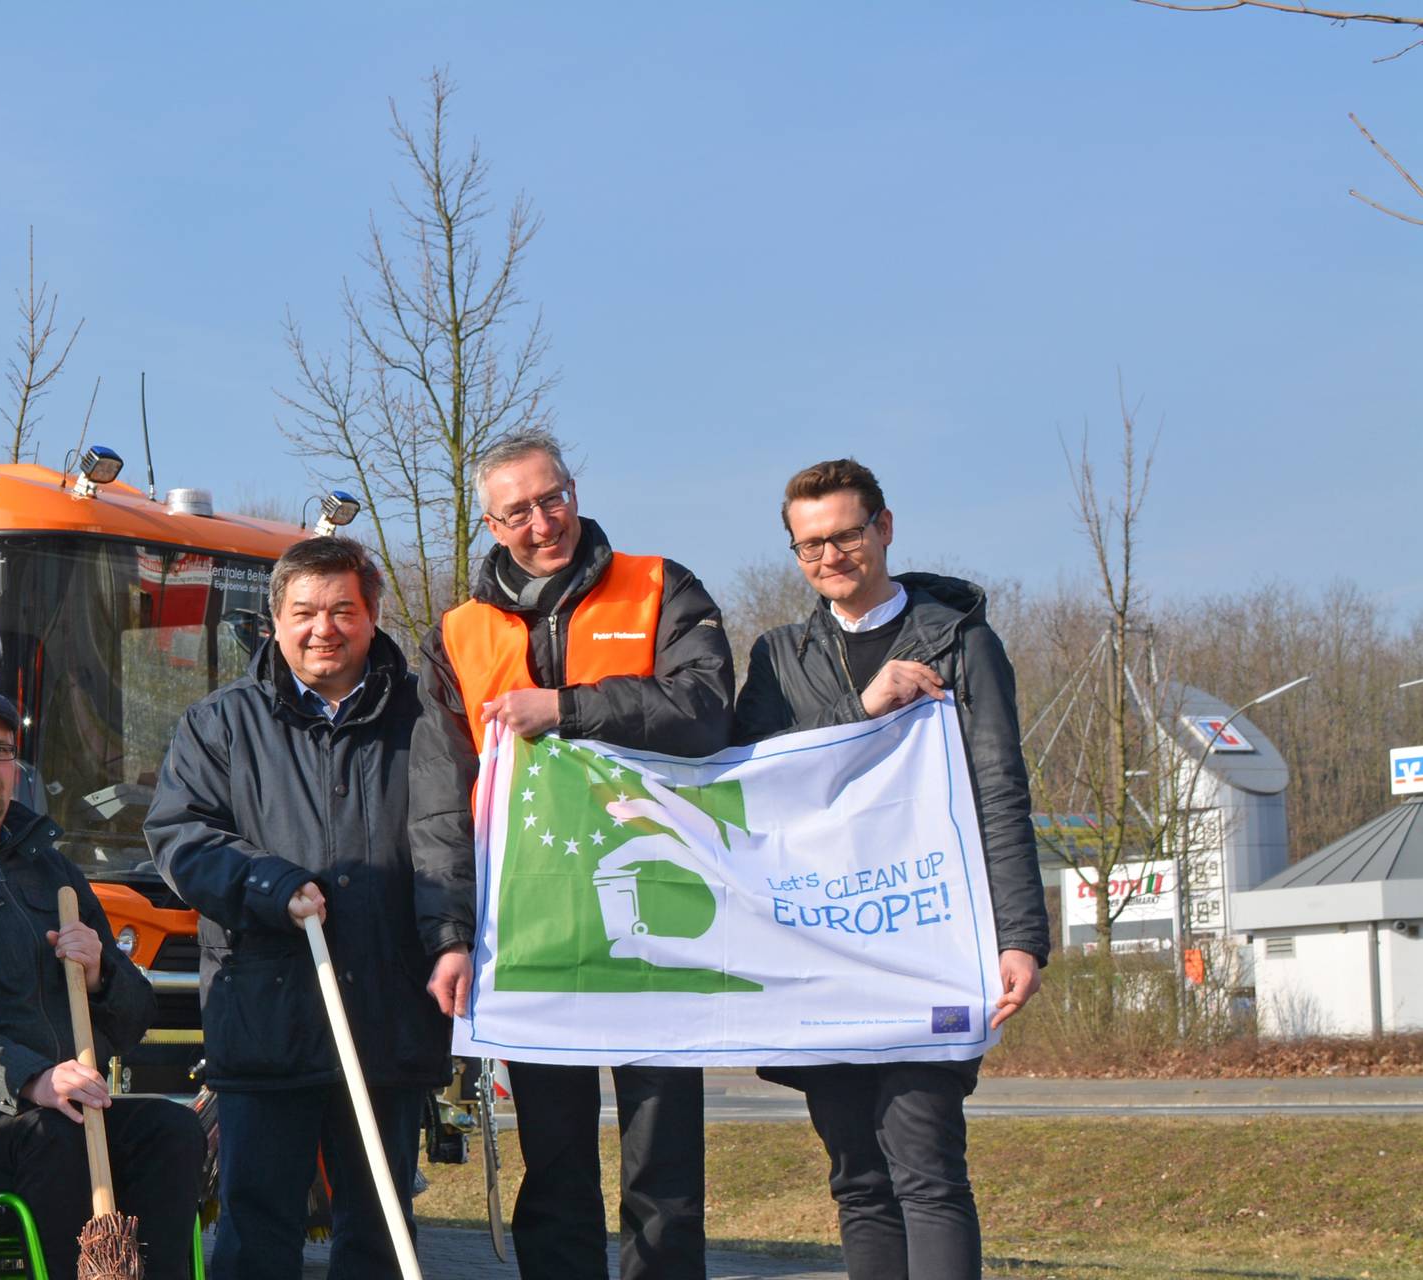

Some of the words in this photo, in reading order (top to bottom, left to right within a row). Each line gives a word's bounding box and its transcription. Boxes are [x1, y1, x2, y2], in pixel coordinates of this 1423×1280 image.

[825, 862, 909, 900] CLEAN
[915, 852, 945, 880] UP
[772, 882, 952, 935] EUROPE!
